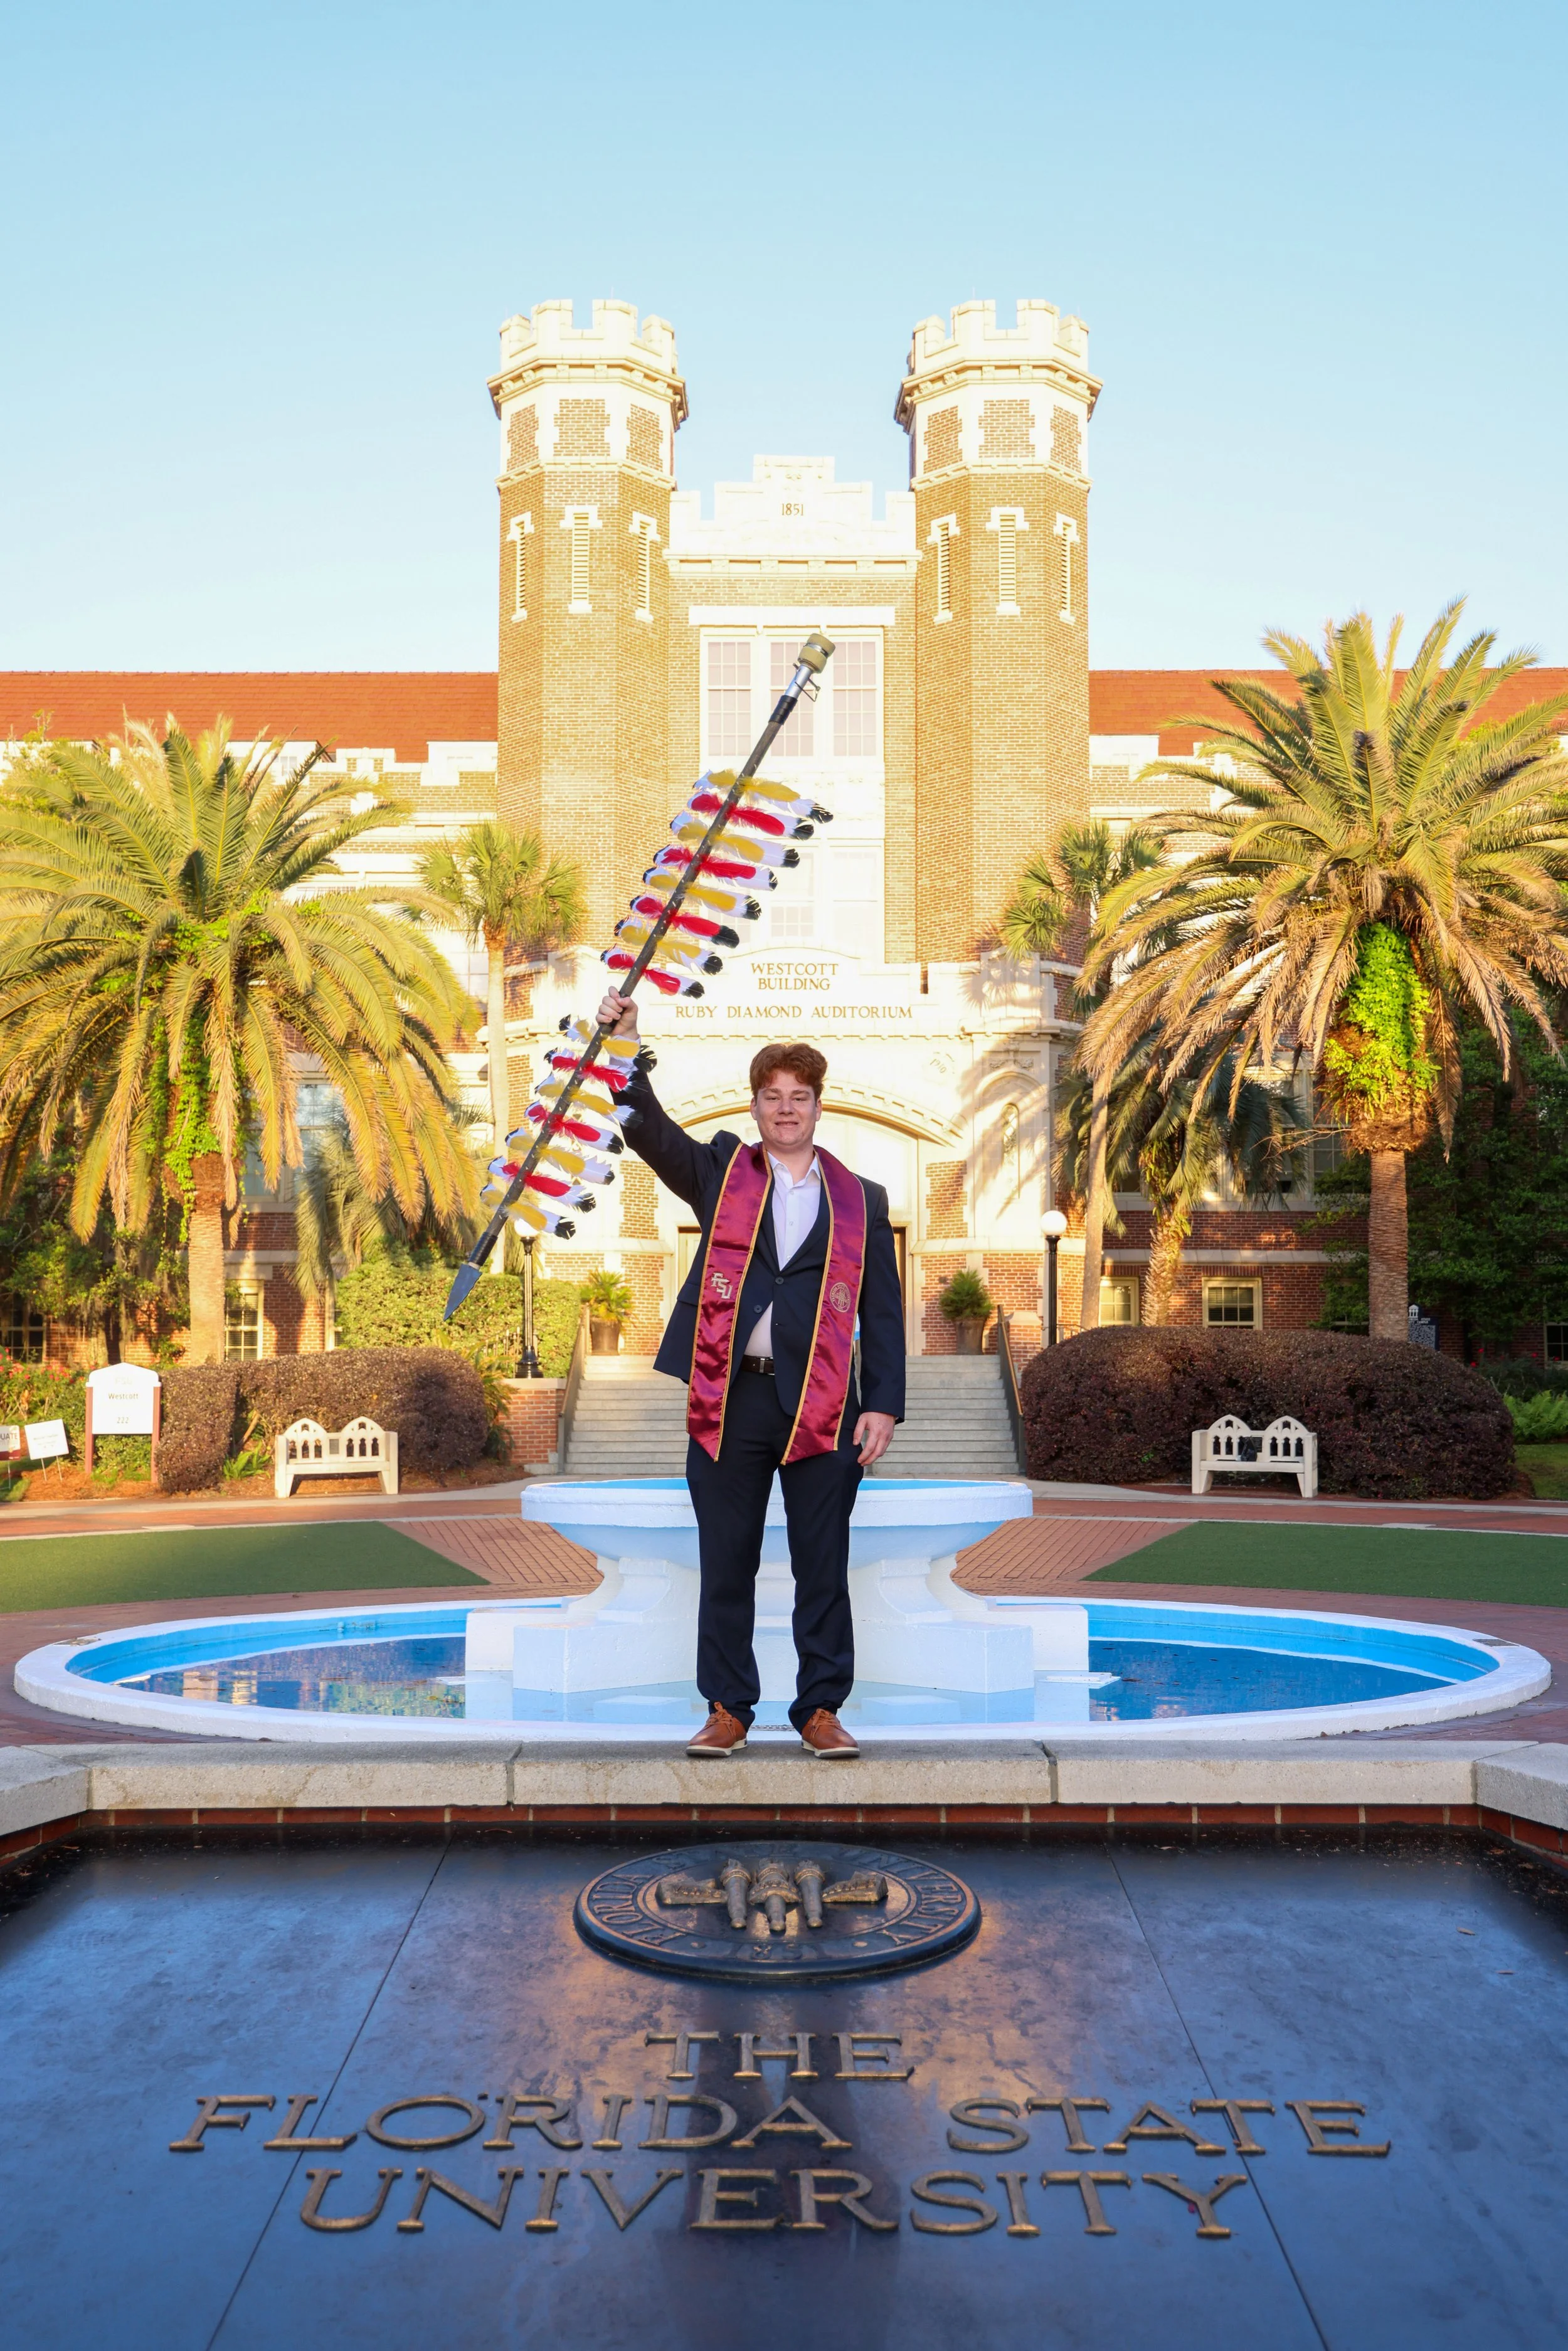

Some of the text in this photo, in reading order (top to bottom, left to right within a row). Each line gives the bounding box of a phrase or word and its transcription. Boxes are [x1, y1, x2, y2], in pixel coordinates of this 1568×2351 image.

[781, 503, 803, 516] 1851
[751, 962, 839, 976] WESTCOTT
[758, 978, 830, 990] BUILDING
[675, 1006, 913, 1019] RUBY DIAMOND AUDITORIUM
[710, 1272, 734, 1299] FSU
[644, 2030, 914, 2080] THE
[168, 2093, 1391, 2157] FLORIDA STATE
[300, 2167, 1248, 2237] UNIVERSITY
